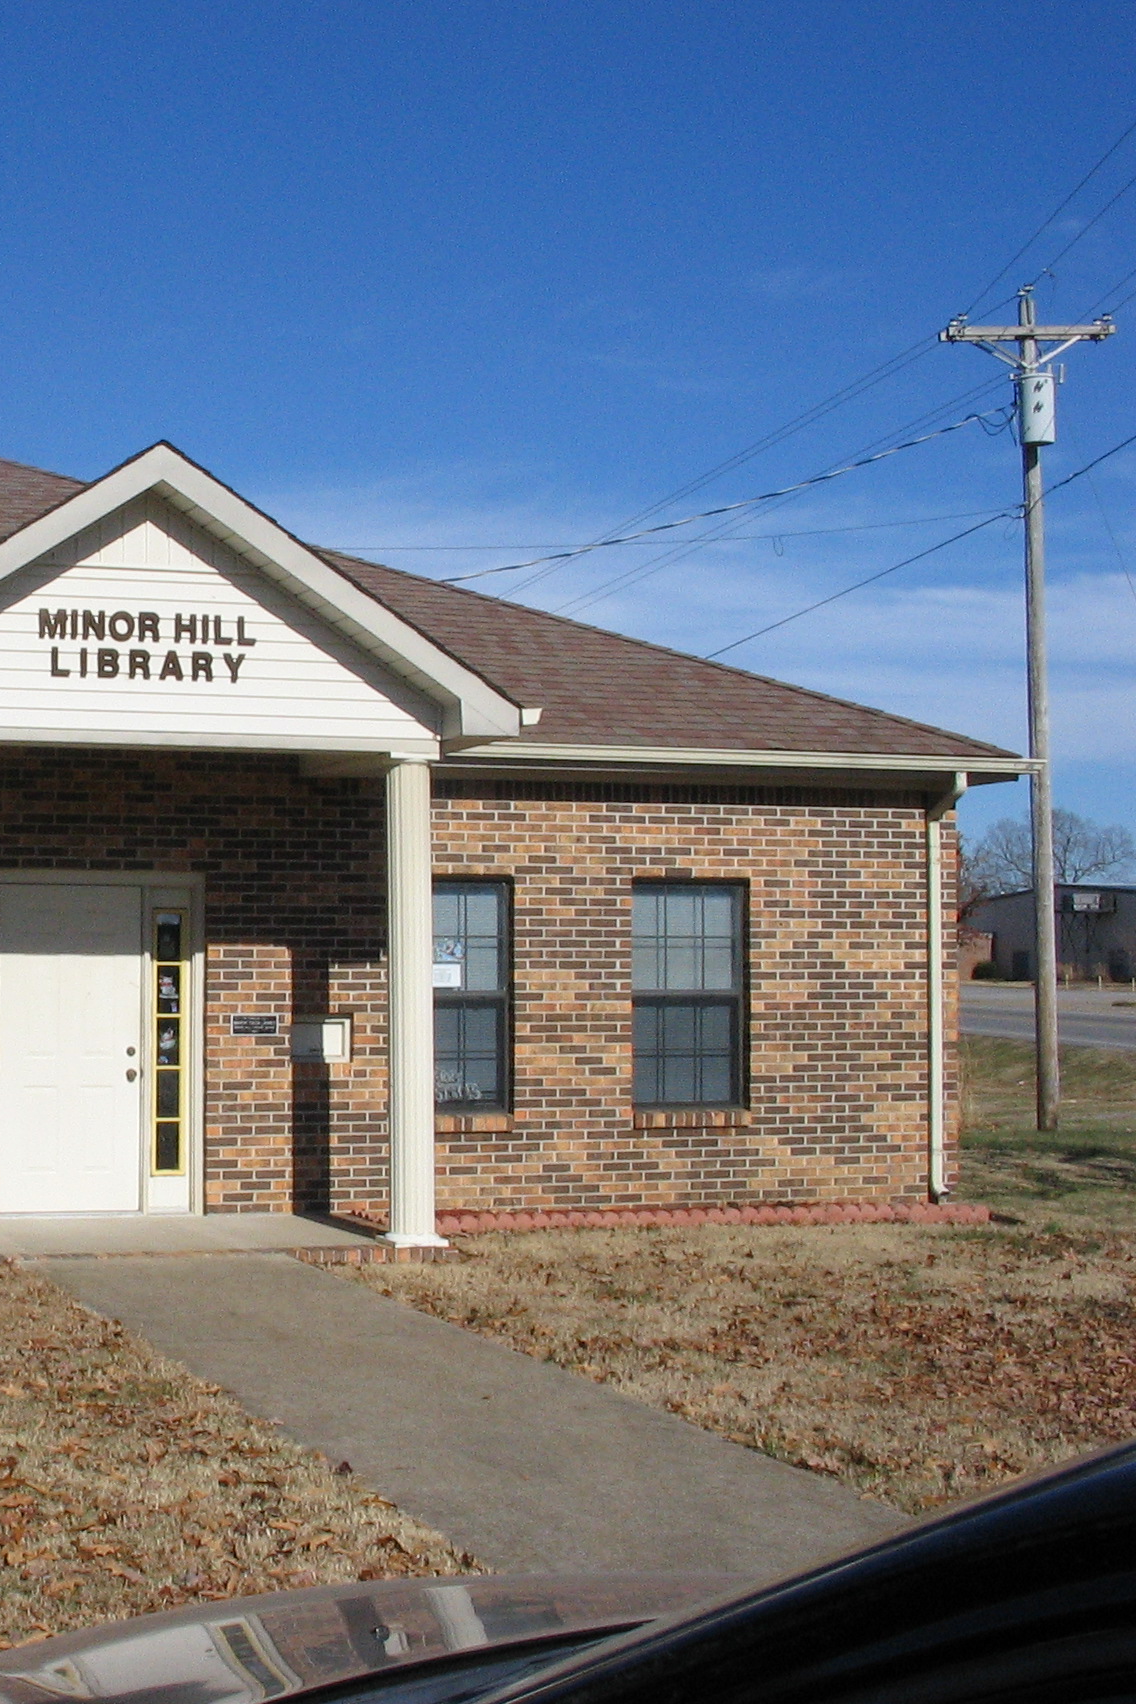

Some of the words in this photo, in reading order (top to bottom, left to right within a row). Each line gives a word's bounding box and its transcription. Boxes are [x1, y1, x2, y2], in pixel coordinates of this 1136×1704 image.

[38, 608, 161, 643] MINOR
[174, 613, 257, 647] HILL
[50, 647, 246, 684] LIBRARY
